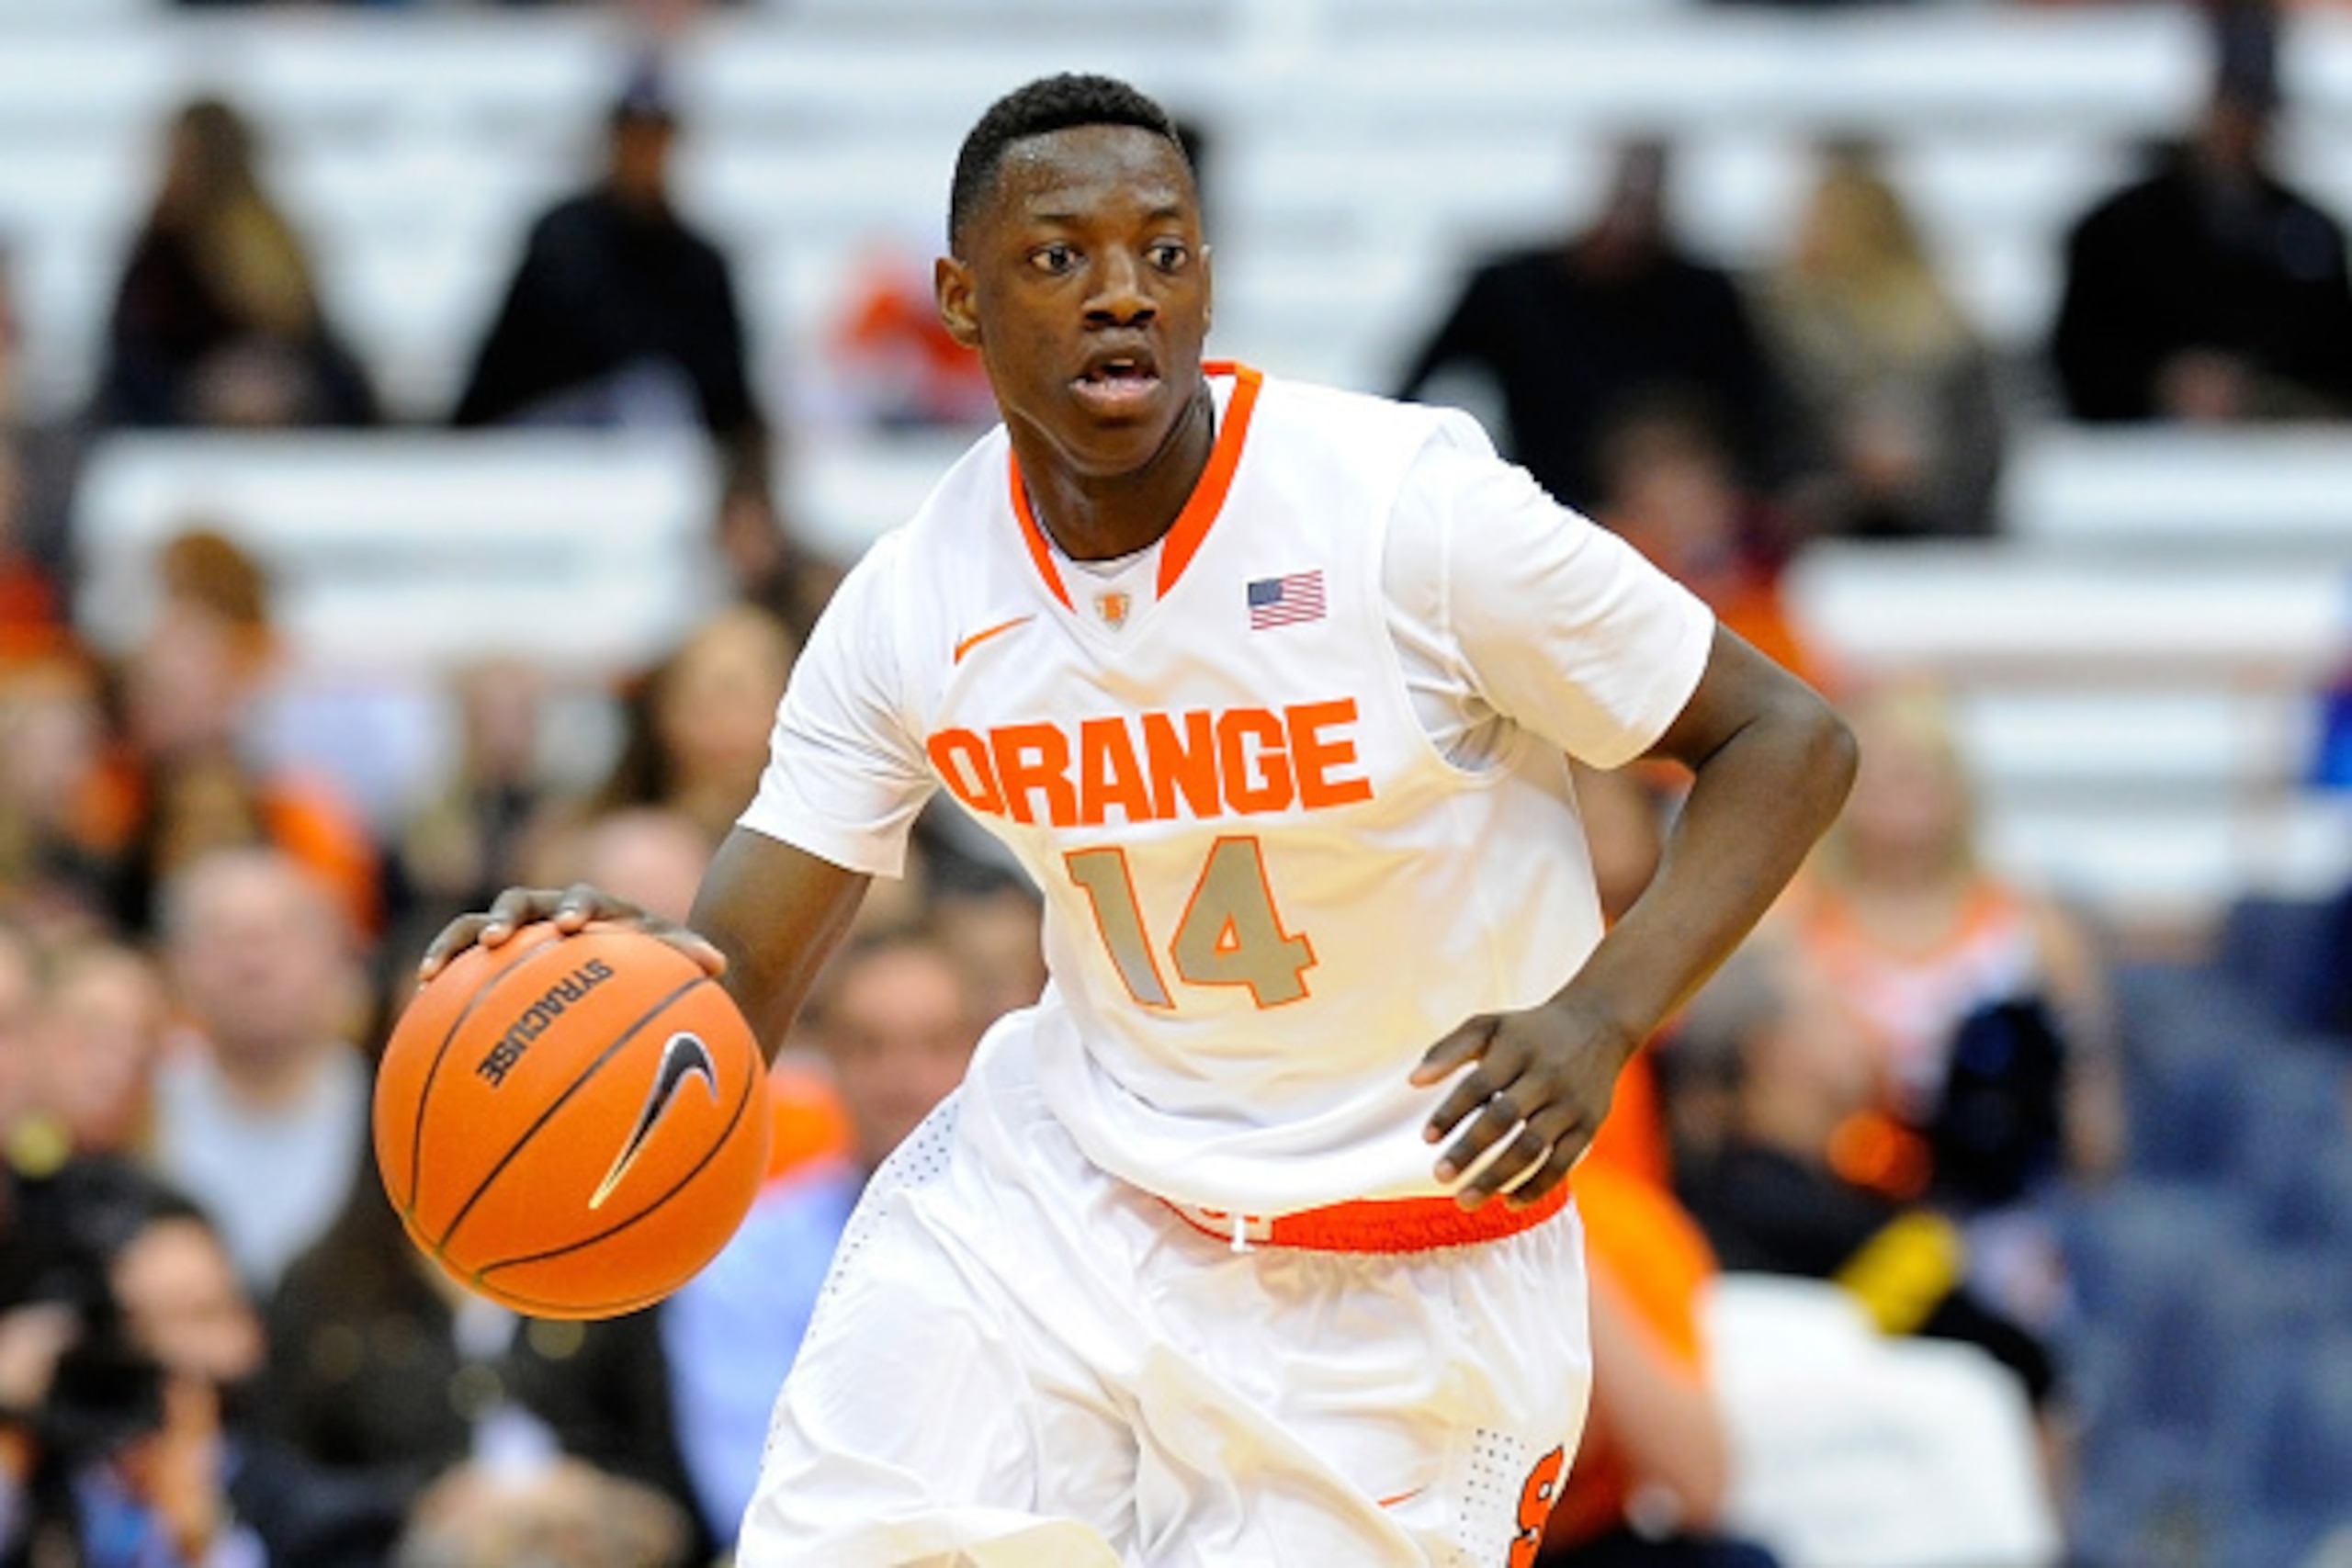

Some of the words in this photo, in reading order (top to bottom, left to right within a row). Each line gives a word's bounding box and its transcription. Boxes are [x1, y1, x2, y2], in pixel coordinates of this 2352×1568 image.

[926, 697, 1374, 828] ORANGE
[1062, 833, 1319, 1010] 14
[475, 958, 614, 1088] SYRACUSE
